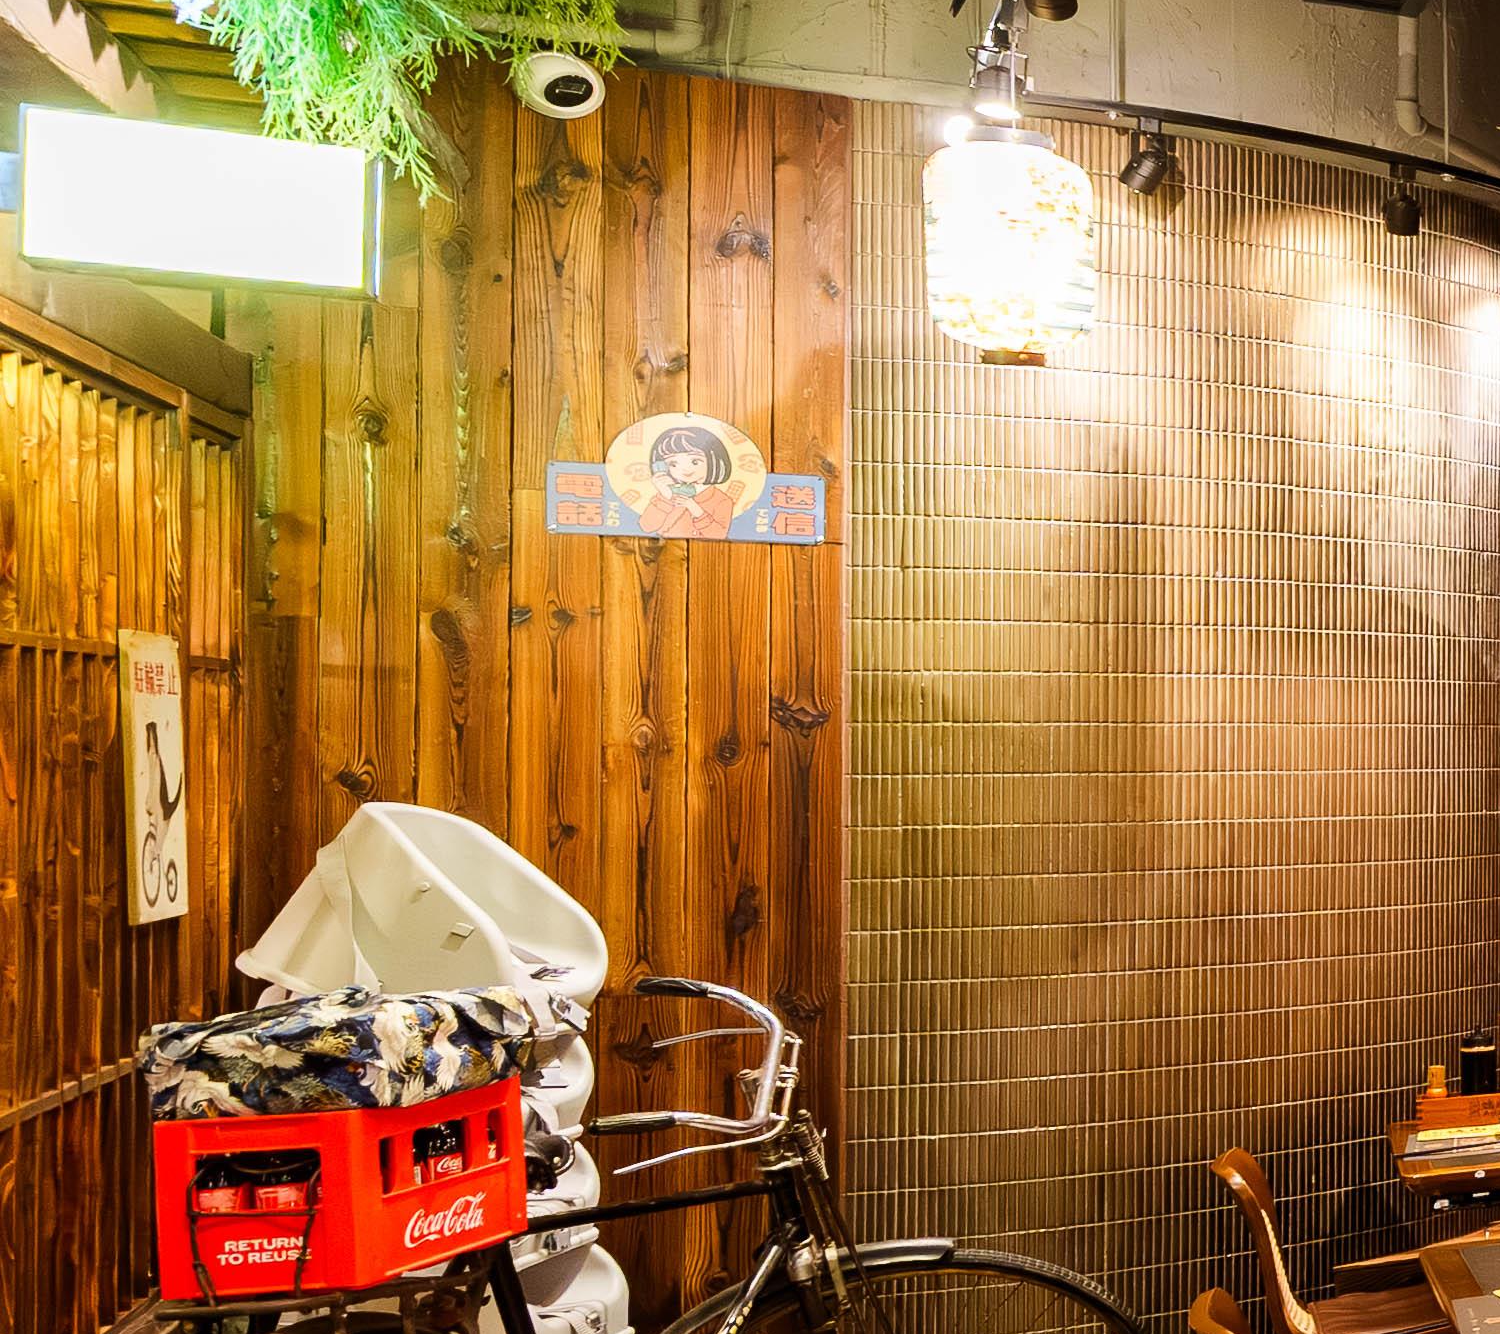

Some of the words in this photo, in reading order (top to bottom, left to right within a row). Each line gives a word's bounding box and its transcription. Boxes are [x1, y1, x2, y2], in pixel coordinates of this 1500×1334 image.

[404, 1191, 486, 1249] Coca-Cola
[224, 1235, 305, 1253] RETURN
[216, 1253, 245, 1267] TO
